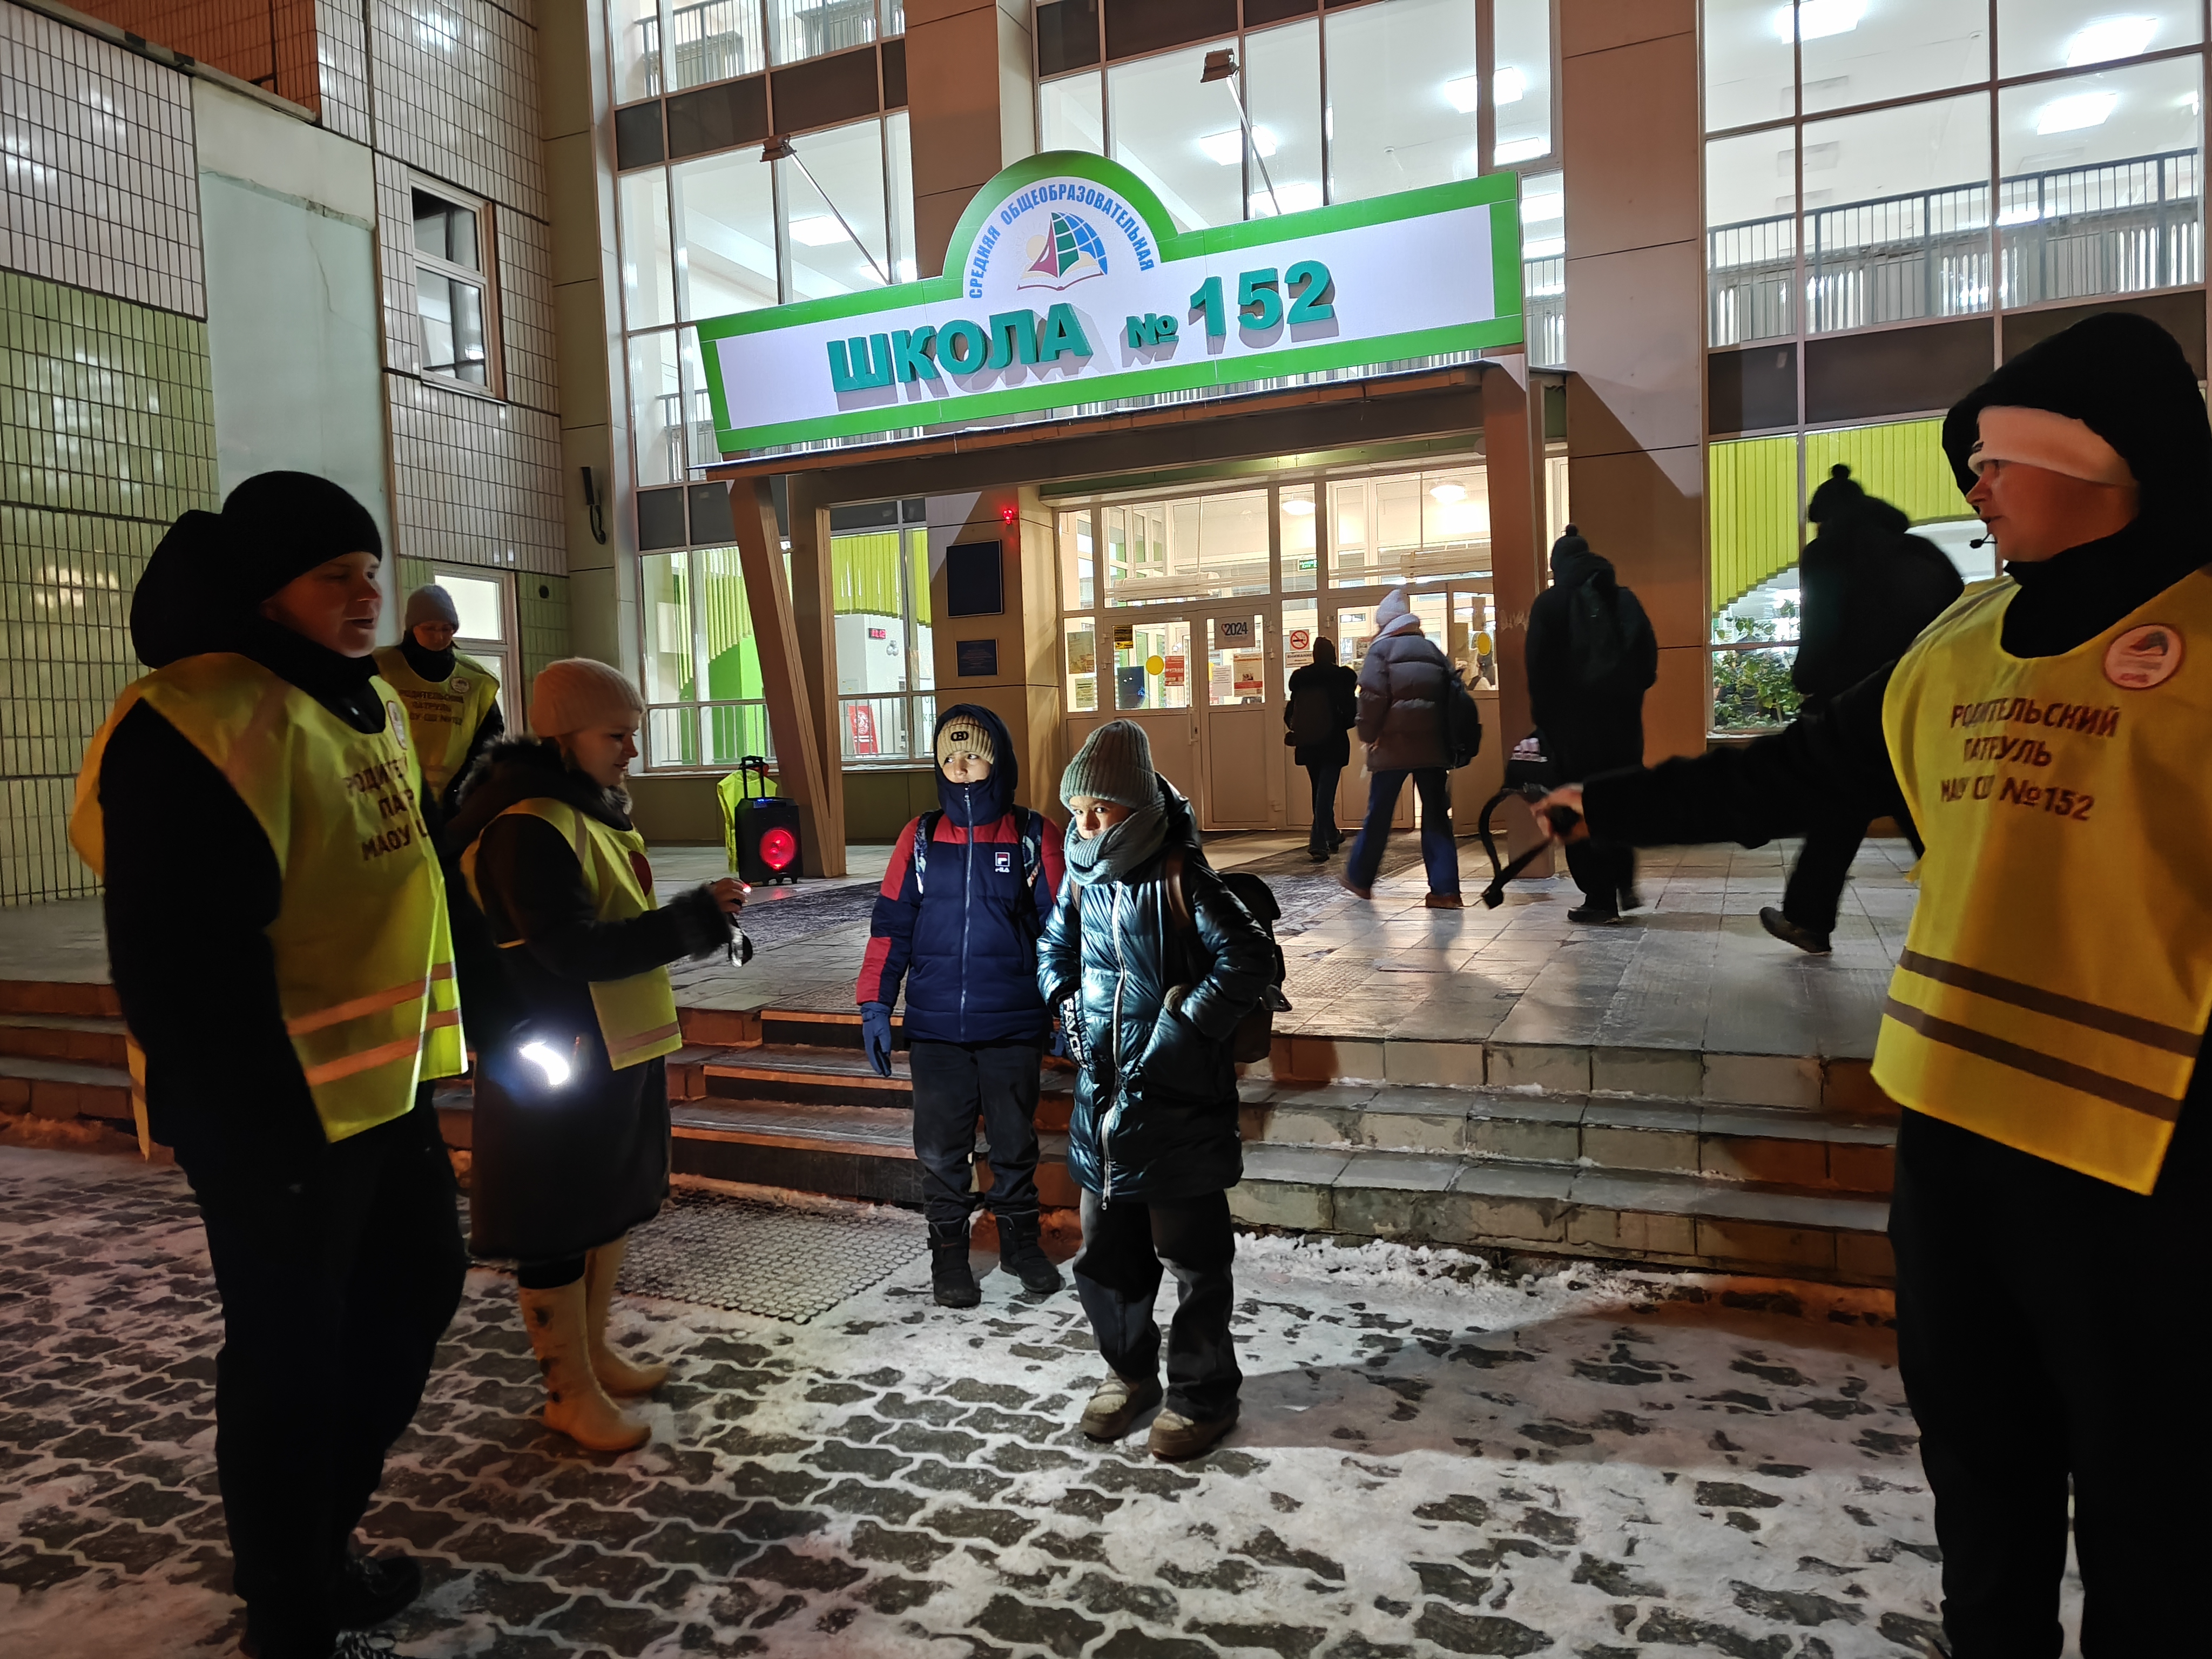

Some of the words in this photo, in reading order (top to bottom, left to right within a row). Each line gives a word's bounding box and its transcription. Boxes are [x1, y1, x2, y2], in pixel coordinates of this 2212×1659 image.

[969, 225, 1001, 299] СРЕДНЯЯ
[1000, 184, 1155, 272] ОБЩЕОБРАЗОВАТЕЛЬНАЯ
[826, 302, 1094, 393] ШКОЛА
[1224, 622, 1248, 636] 2024
[362, 825, 411, 861] МАОУ
